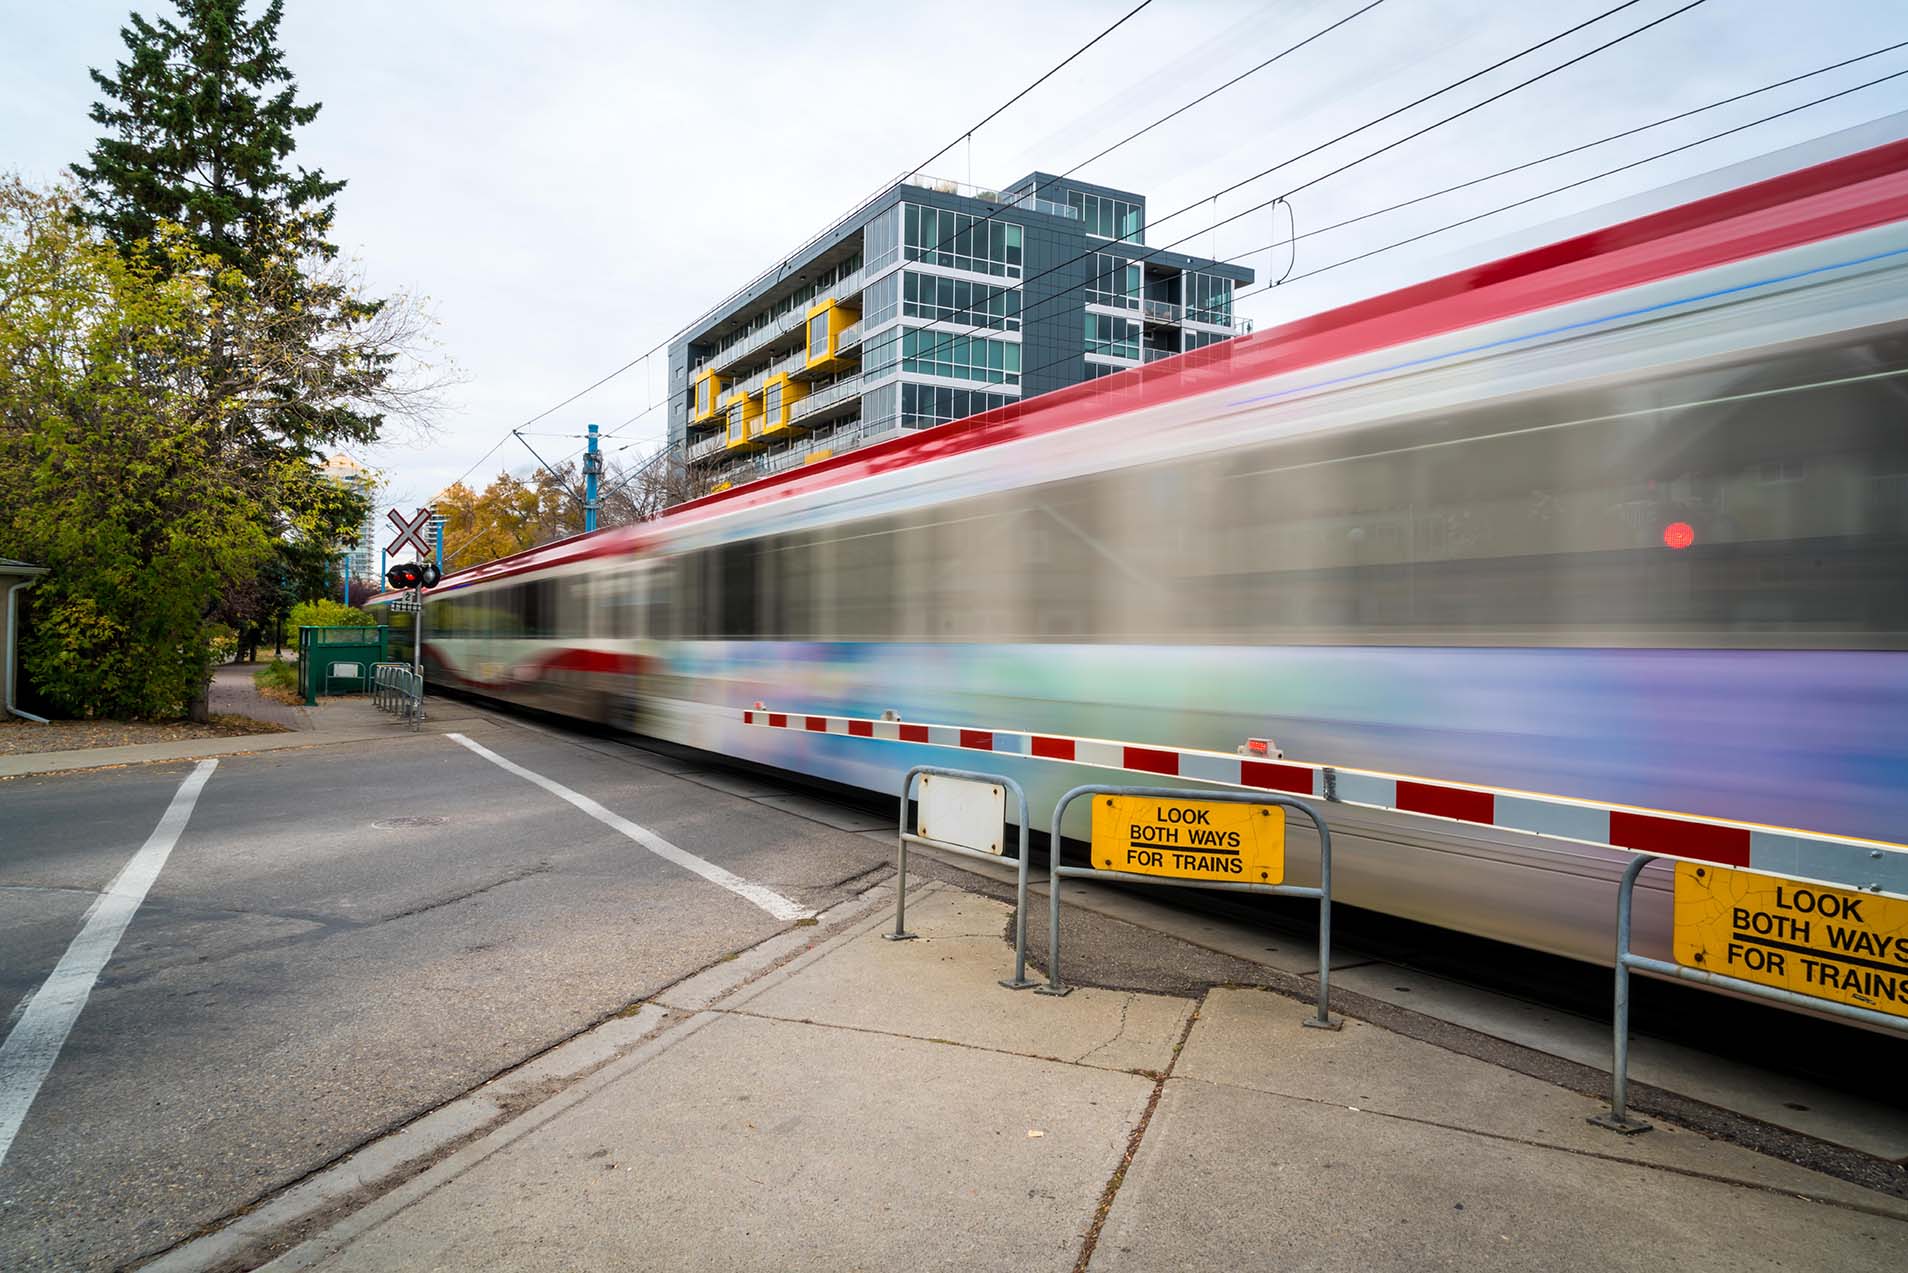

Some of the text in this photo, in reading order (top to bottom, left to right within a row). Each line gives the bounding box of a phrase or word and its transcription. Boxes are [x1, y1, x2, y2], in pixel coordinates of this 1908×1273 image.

[1157, 807, 1210, 825] LOOK
[1130, 824, 1241, 848] BOTH WAYS
[1127, 849, 1243, 874] FOR TRAINS
[1776, 886, 1865, 923] LOOK
[1733, 907, 1811, 943] BOTH
[1727, 943, 1786, 976] FOR
